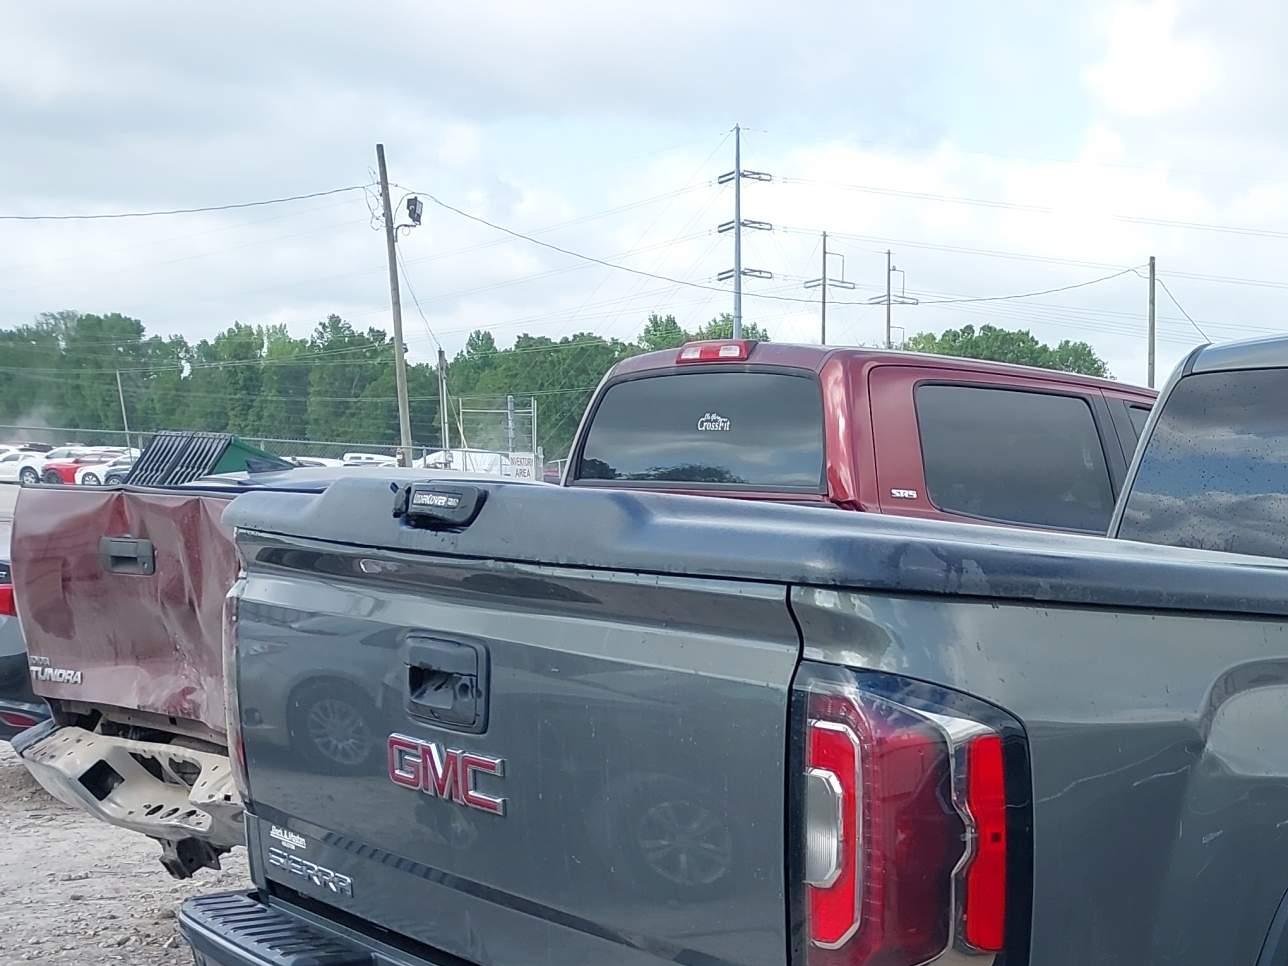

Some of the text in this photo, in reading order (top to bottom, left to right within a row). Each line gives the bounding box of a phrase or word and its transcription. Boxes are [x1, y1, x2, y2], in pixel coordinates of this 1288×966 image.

[698, 417, 731, 431] CrossFit
[515, 468, 531, 478] AREA
[29, 666, 83, 685] TUNDRA
[387, 733, 506, 816] GMC
[268, 846, 354, 898] SIERRA
